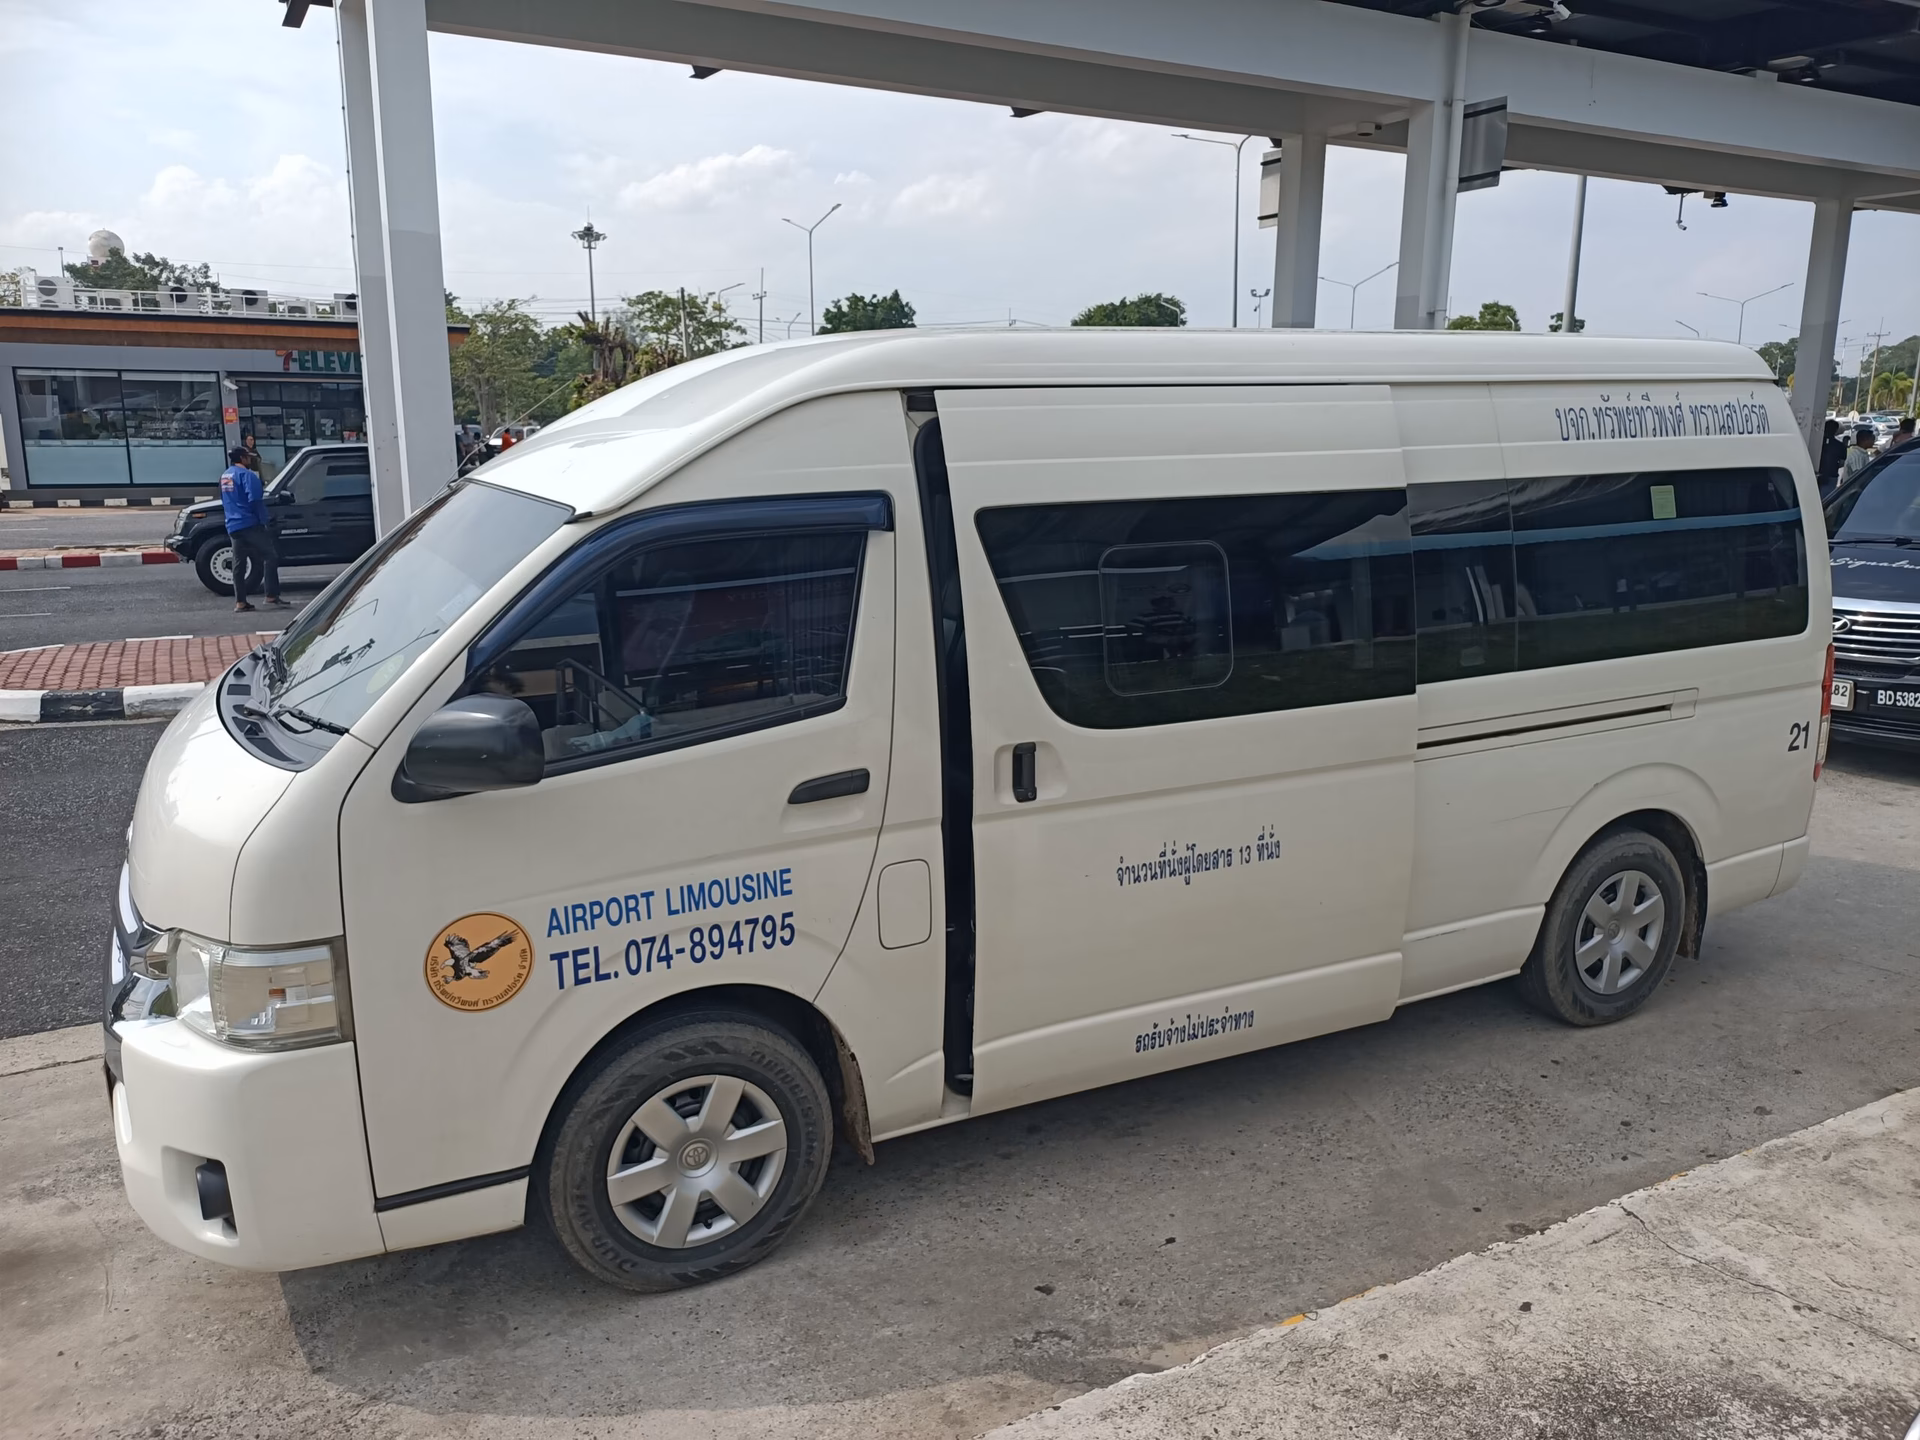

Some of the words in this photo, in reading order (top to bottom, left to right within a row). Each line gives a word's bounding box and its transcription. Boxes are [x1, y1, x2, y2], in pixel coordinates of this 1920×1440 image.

[1788, 721, 1810, 752] 21
[1239, 845, 1252, 865] 13
[547, 890, 655, 938] AIRPORT
[666, 868, 793, 916] LIMOUSINE
